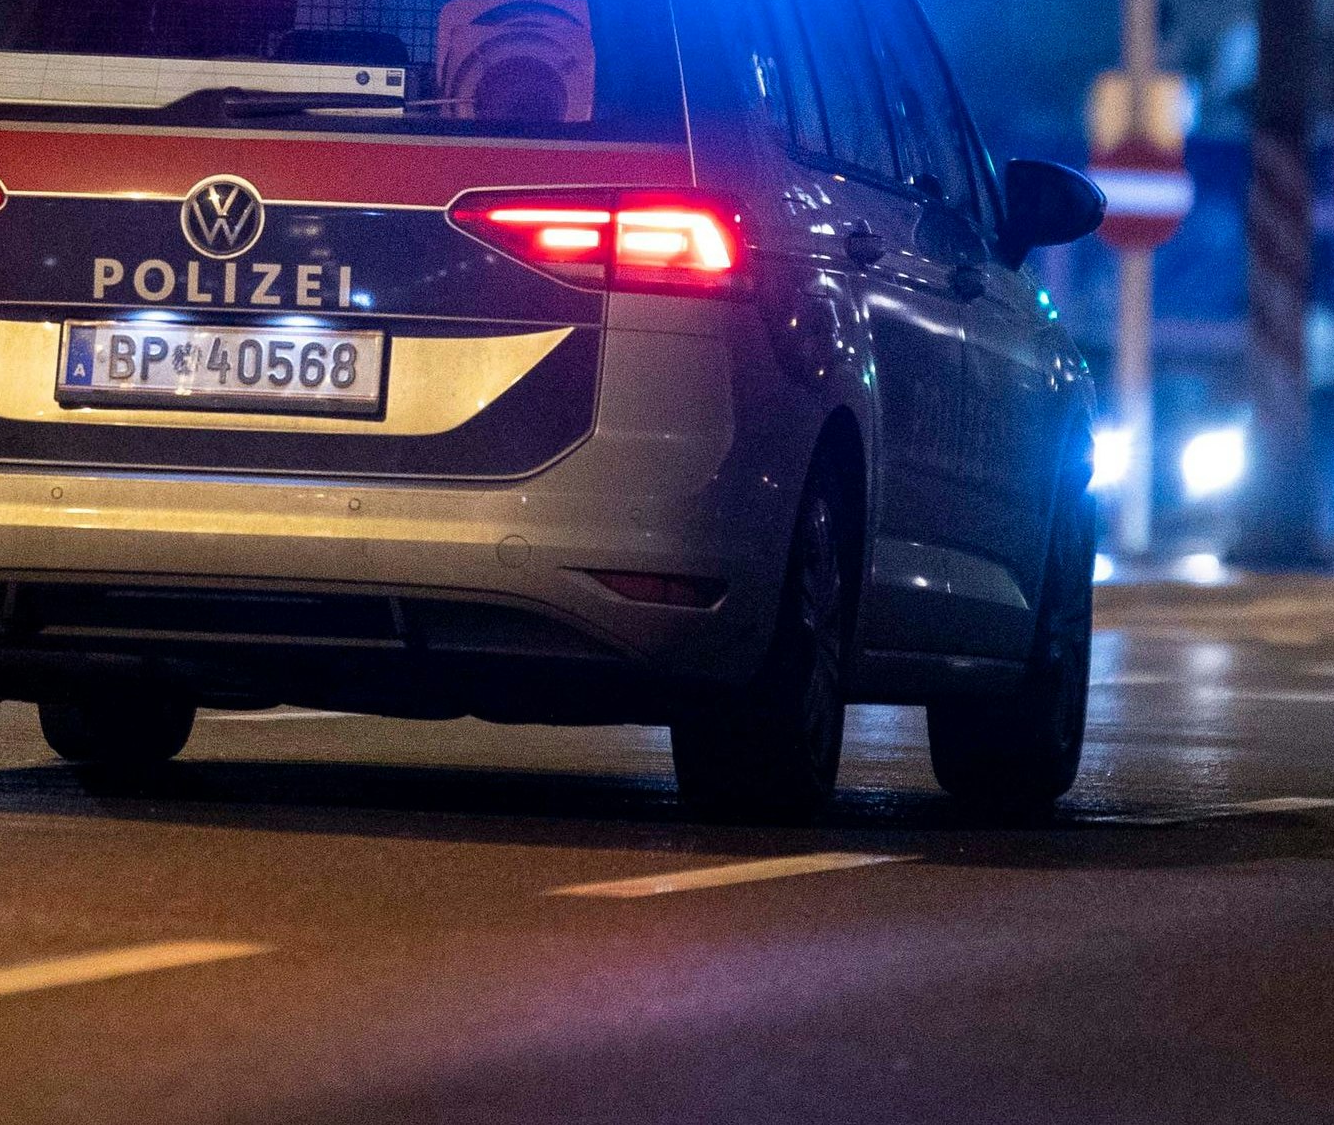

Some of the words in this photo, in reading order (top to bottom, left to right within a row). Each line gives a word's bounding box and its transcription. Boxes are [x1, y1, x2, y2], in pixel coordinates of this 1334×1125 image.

[186, 179, 260, 253] VW
[93, 258, 351, 307] POLIZEI
[73, 363, 86, 377] A
[108, 334, 168, 381] BP
[206, 337, 358, 388] 40568
